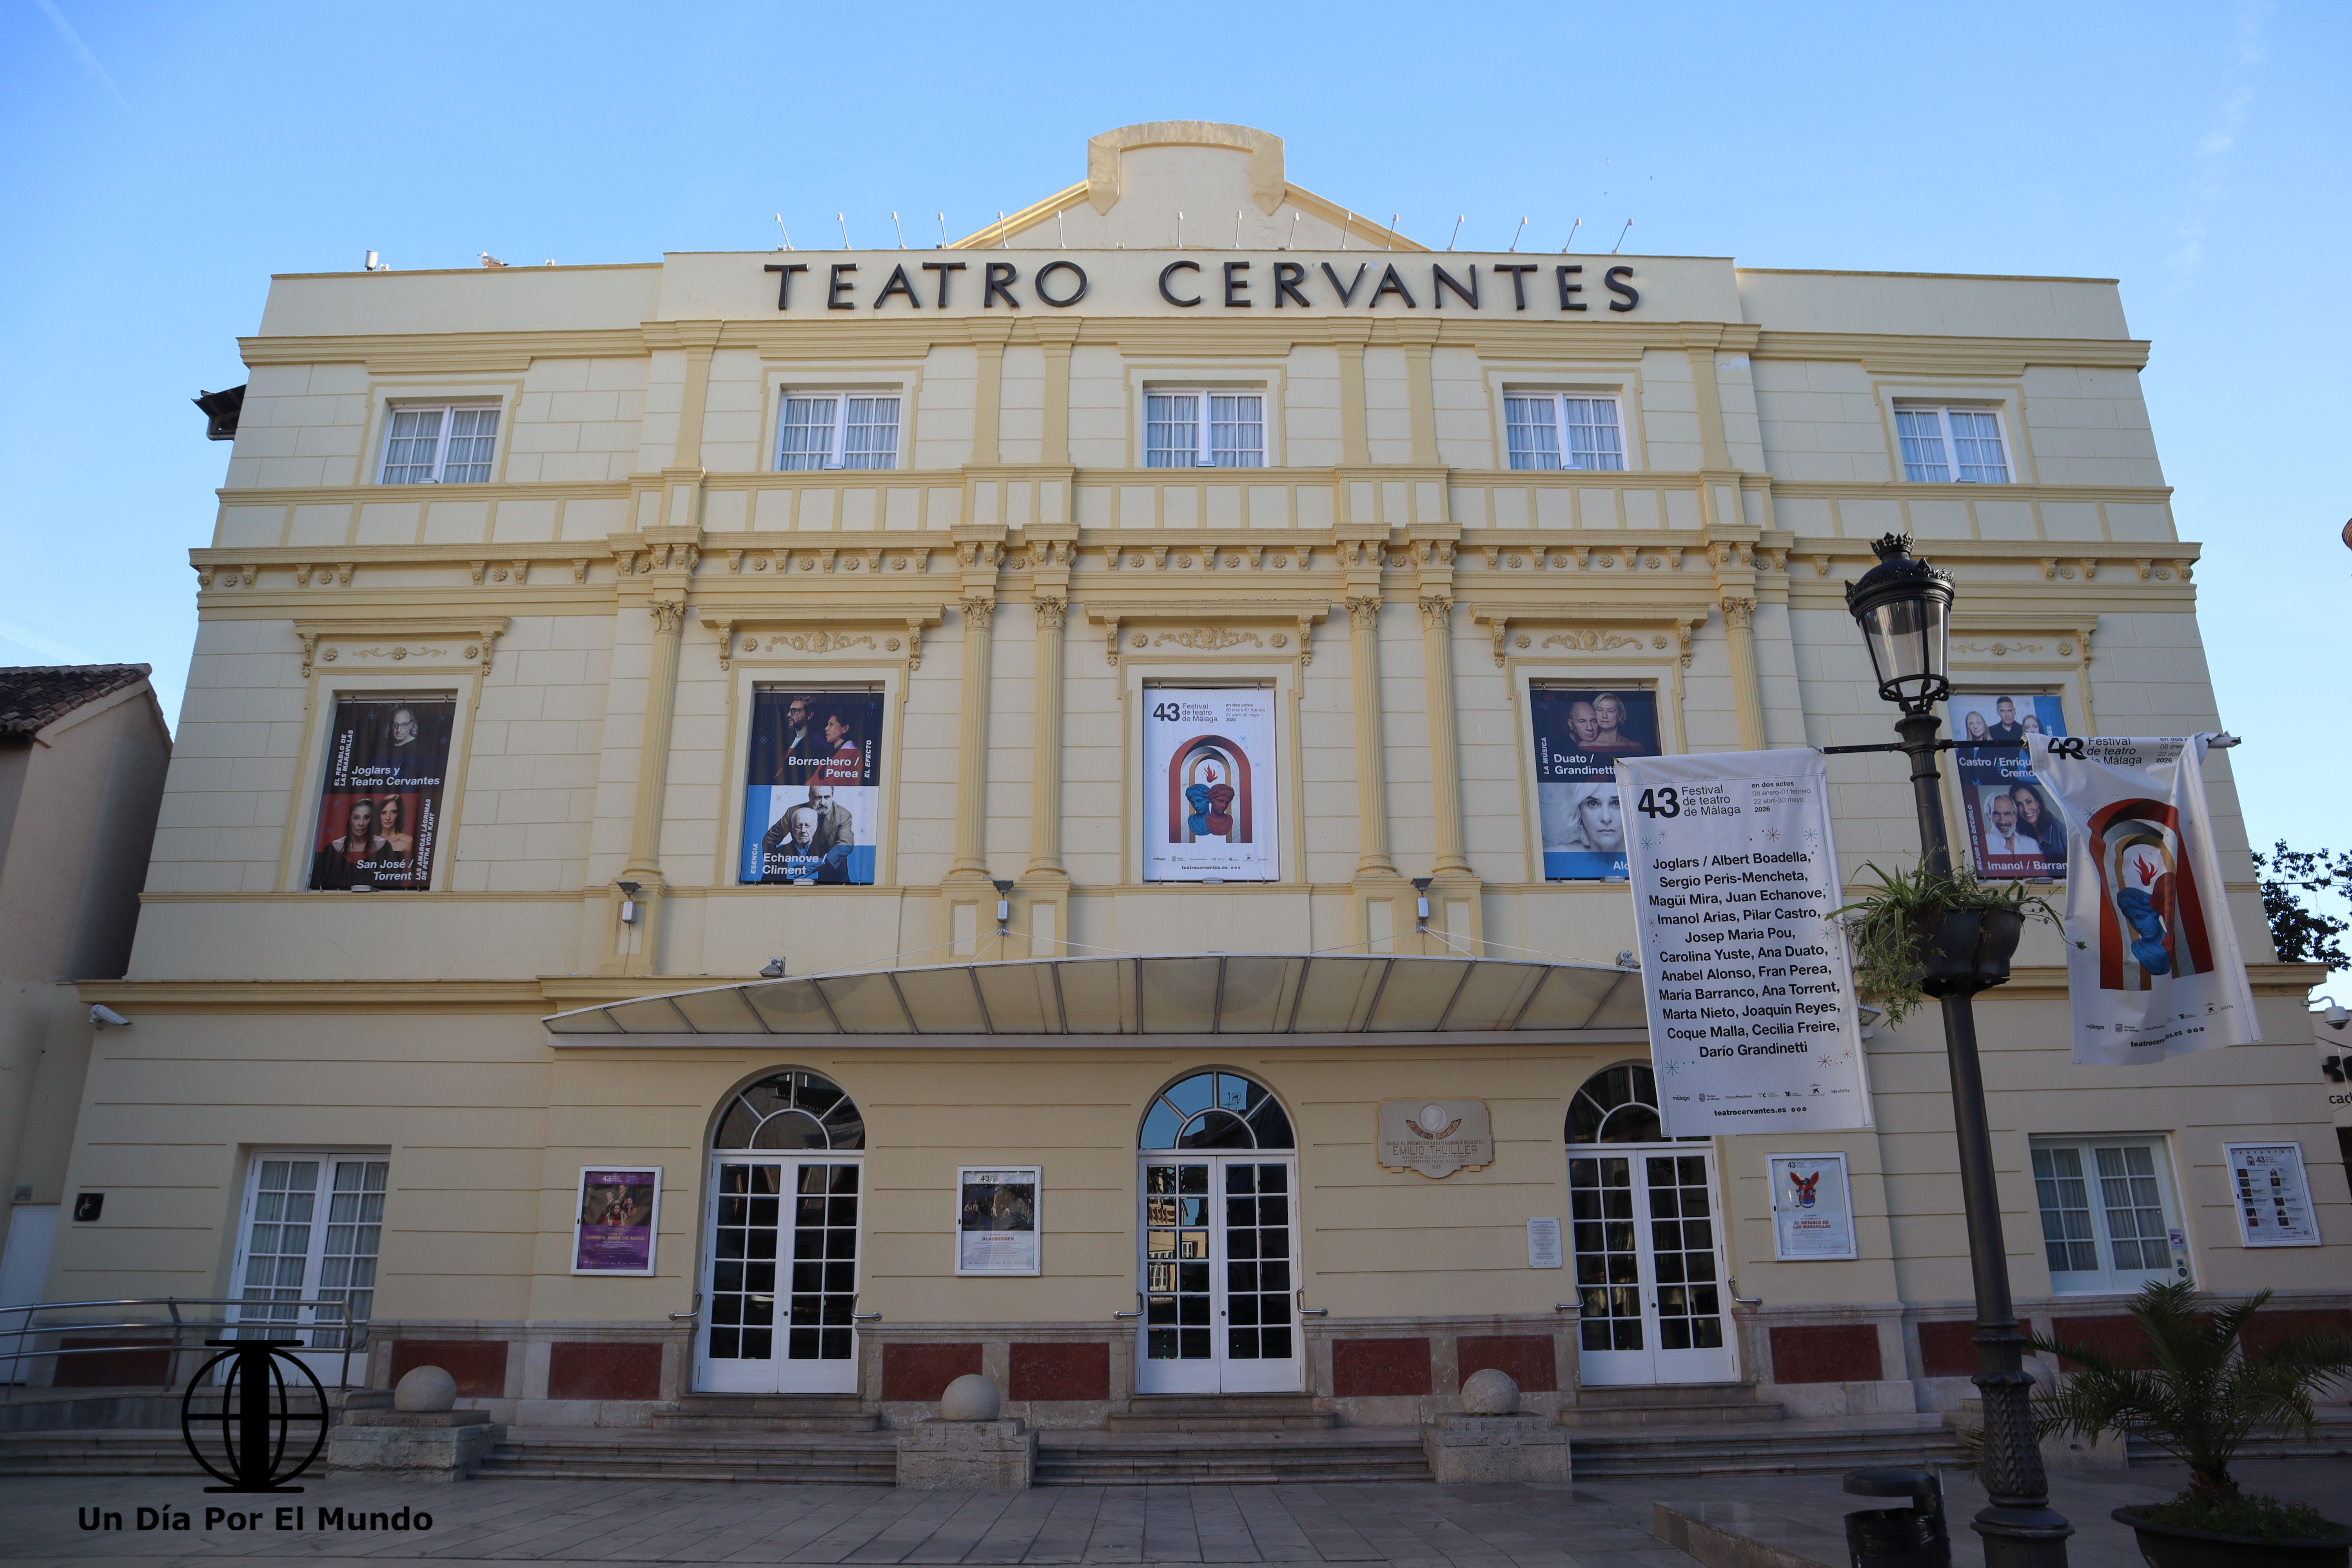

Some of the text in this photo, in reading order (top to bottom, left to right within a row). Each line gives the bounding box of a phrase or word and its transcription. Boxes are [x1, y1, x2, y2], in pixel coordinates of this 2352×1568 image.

[764, 260, 1640, 312] TEATRO CERVANTES
[1153, 703, 1180, 721] 43
[2089, 737, 2131, 746] Festival
[342, 730, 353, 771] MARAVILLAS
[334, 734, 347, 786] EL RETABLO DE
[789, 757, 851, 766] Borrachero
[1554, 754, 1587, 763] Duato
[1959, 757, 2031, 767] Castro Enríqu
[2104, 755, 2142, 766] Málaga
[352, 766, 400, 776] Joglars y
[826, 769, 858, 778] Perea
[1544, 766, 1549, 774] LA
[1555, 766, 1615, 775] Grandinetti
[351, 777, 440, 786] Teatro Cervantes
[1682, 784, 1723, 795] Festival
[1638, 788, 1680, 818] 43
[1683, 795, 1730, 806] de teatro
[421, 799, 431, 832] LÁGRIMAS
[1684, 806, 1741, 817] de Málaga
[1968, 804, 1976, 833] DECIRLO
[1973, 835, 1978, 845] NO
[417, 834, 426, 866] AMARGAS
[764, 853, 819, 862] Echanove
[1653, 851, 1811, 871] Joglars Albert Boadella,
[357, 860, 406, 869] San José
[762, 865, 806, 874] Climent
[1613, 861, 1629, 870] Alo
[1988, 861, 2067, 870] Imanol Barran
[374, 872, 412, 880] Torrent
[421, 871, 427, 880] DE
[1659, 870, 1808, 889] Sergio Peris-Mencheta,
[1649, 889, 1826, 909] Magüi Mira, Juan Echanove,
[1657, 907, 1821, 925] Imanol Arias, Pilar Castro,
[1685, 927, 1795, 944] Josep Maria Pou,
[1660, 944, 1828, 962] Carolina Yuste, Ana Duato,
[1661, 964, 1831, 982] Anabel Alonso, Fran Perea,
[1659, 982, 1840, 1000] María Barranco, Ana Torrent,
[1663, 1002, 1840, 1020] Marta Nieto, Joaquín Reyes,
[1667, 1021, 1840, 1041] Coque Malla, Cecilia Freire,
[1699, 1042, 1808, 1058] Darío Grandinetti
[1714, 1107, 1786, 1116] teatrocervantes.es
[1393, 1145, 1477, 1155] EMILIO THUILLER
